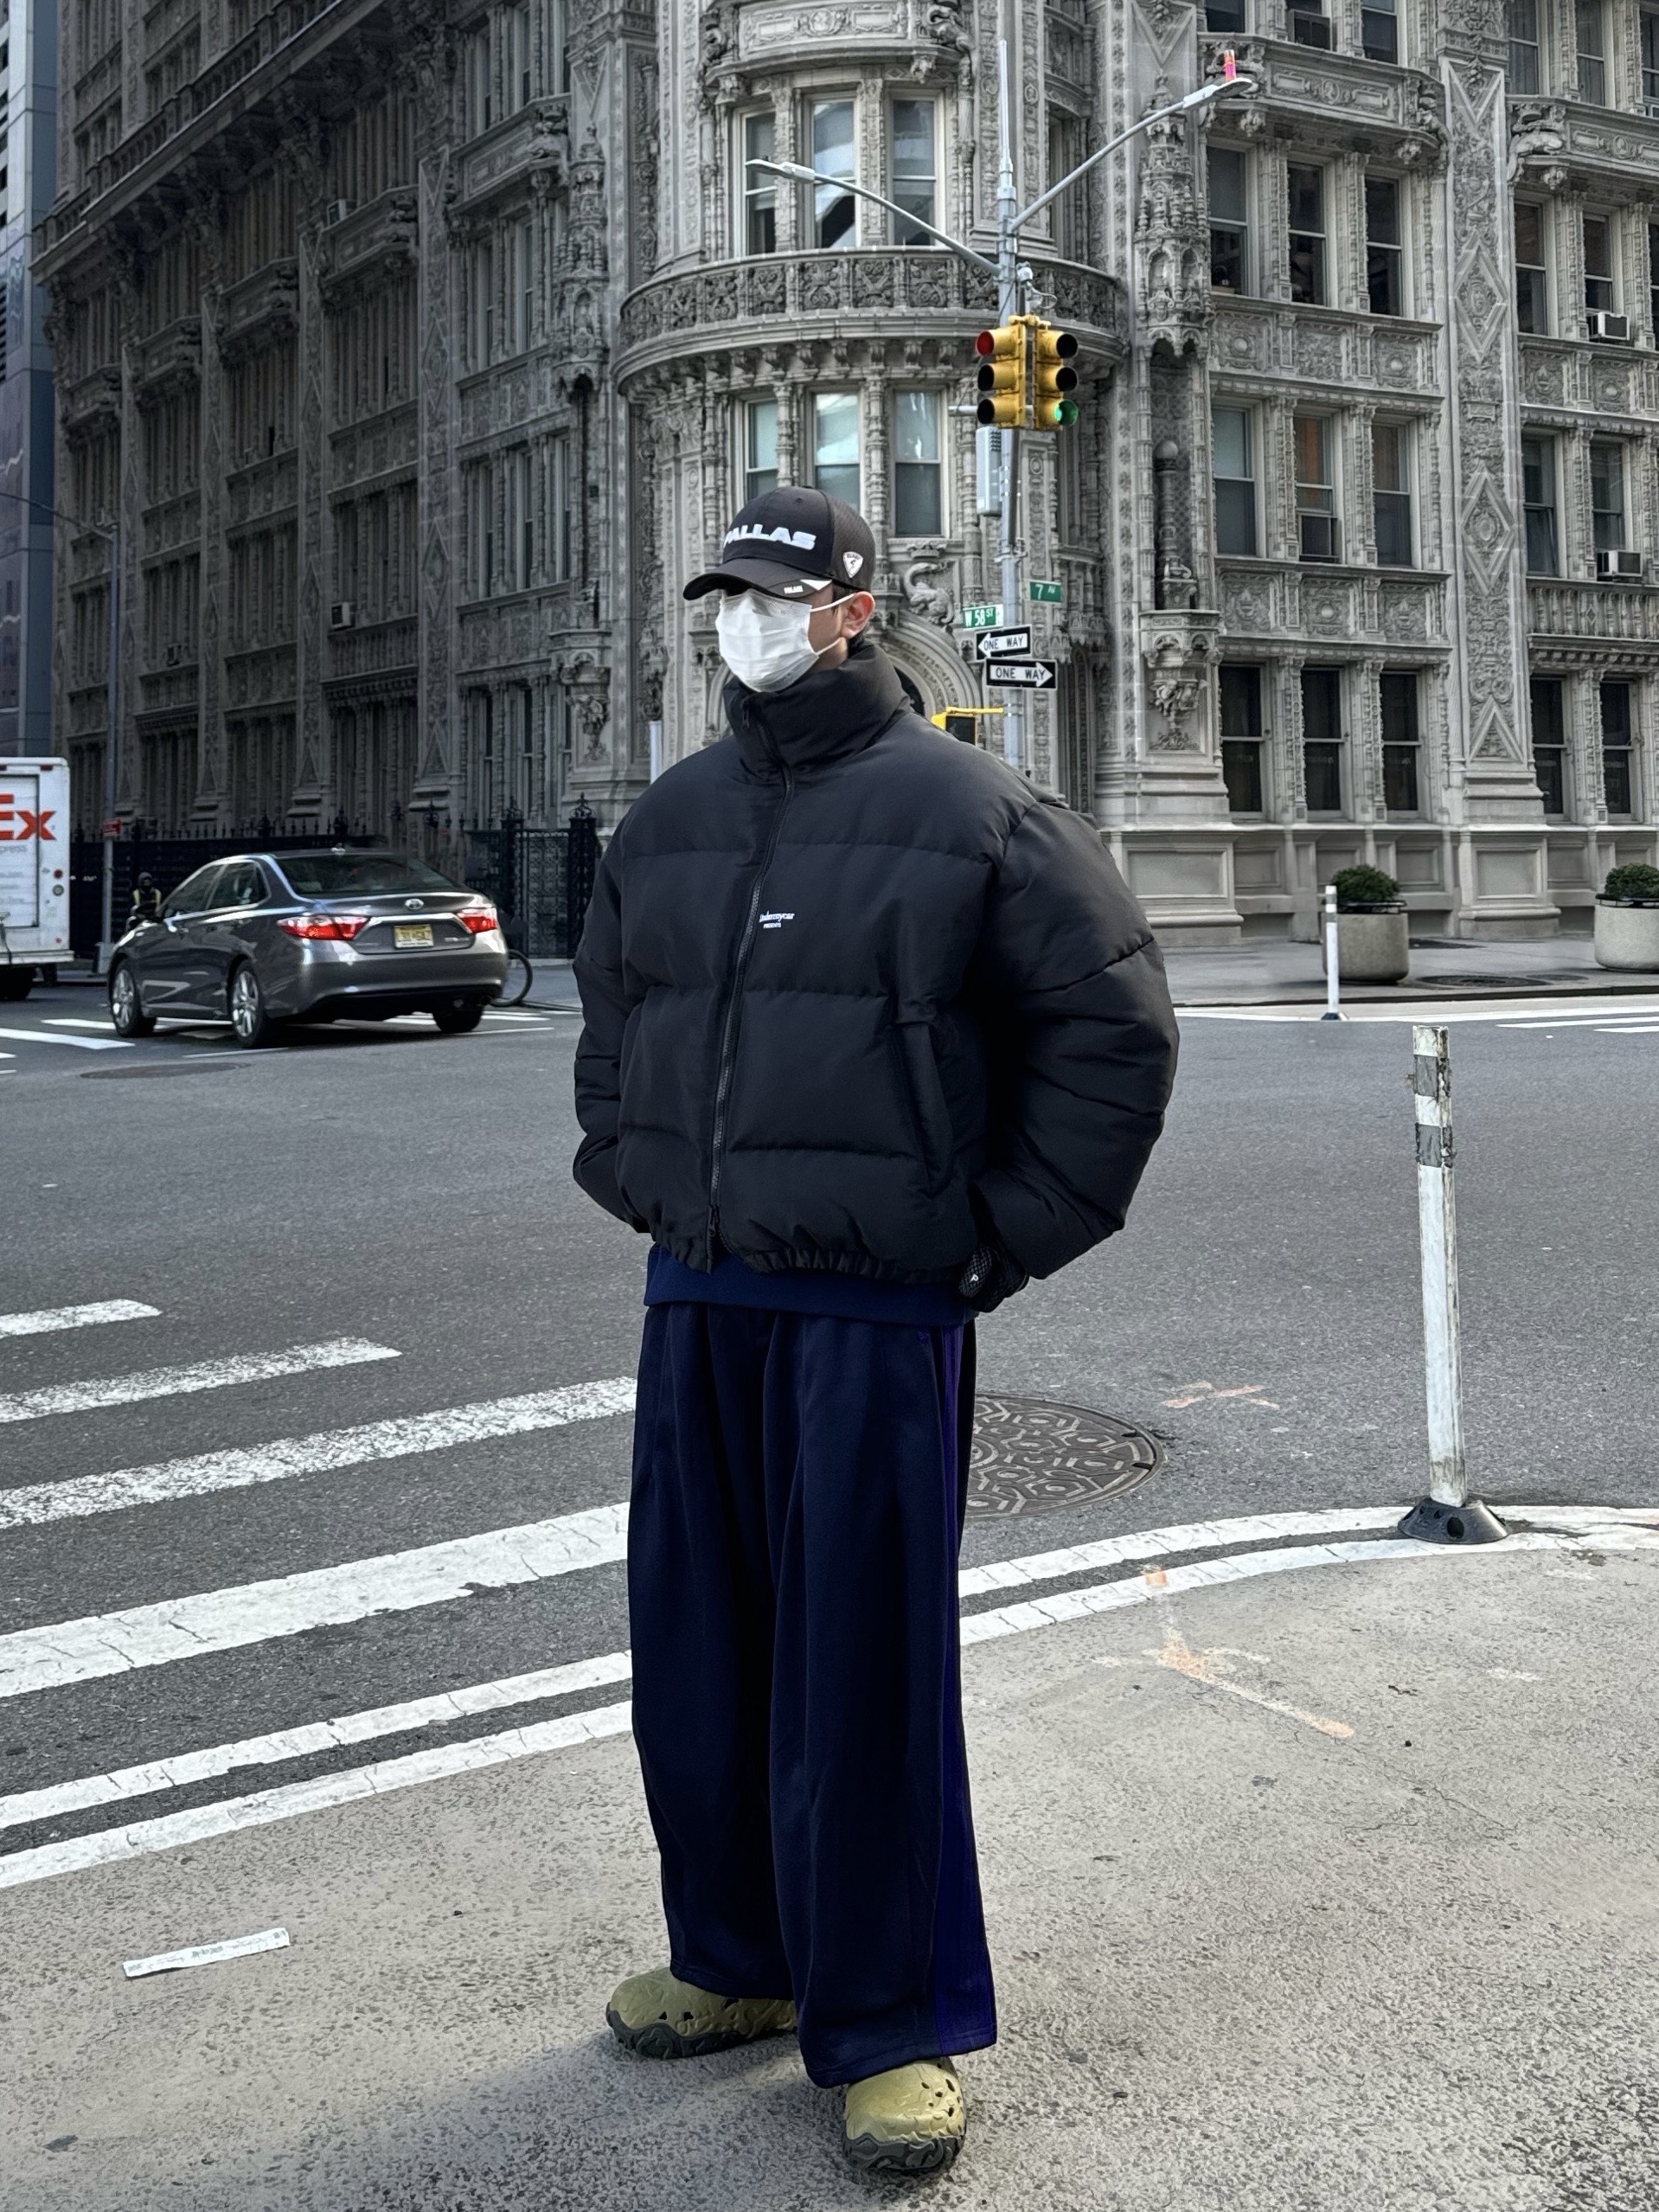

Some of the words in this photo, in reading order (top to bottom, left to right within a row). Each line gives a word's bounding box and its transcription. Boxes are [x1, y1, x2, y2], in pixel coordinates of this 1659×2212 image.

[1034, 584, 1044, 599] 7
[964, 610, 972, 626] W
[975, 609, 986, 625] 58
[983, 638, 999, 651] ONE
[1006, 636, 1023, 647] WAY
[996, 667, 1016, 678] ONE
[1025, 669, 1046, 680] WAY
